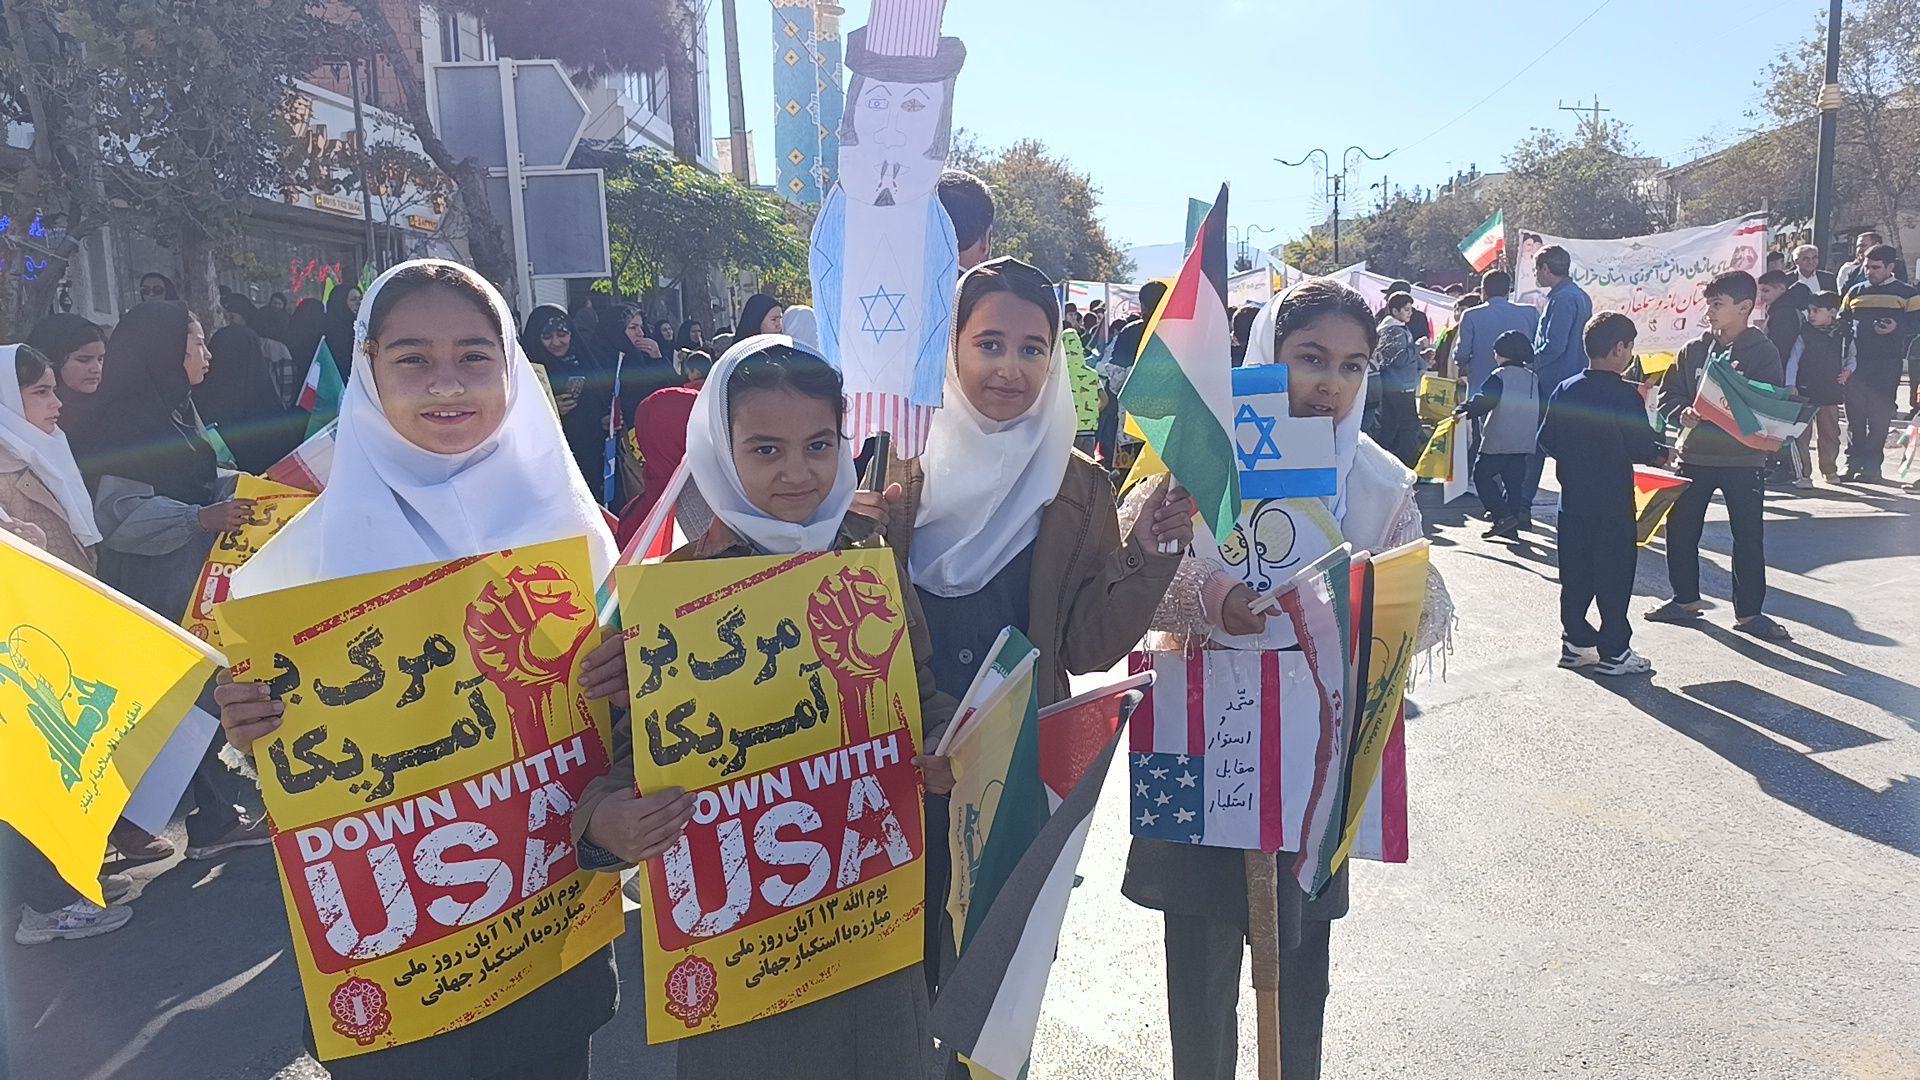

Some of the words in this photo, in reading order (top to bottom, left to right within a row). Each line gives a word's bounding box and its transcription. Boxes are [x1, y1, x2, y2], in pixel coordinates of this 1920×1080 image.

[1572, 267, 1600, 287] خراسا
[1599, 268, 1625, 286] استان
[210, 563, 240, 578] DO
[636, 623, 679, 699] بر
[687, 604, 802, 687] مرگ
[313, 624, 456, 708] مرگ
[645, 660, 831, 777] آمریکا
[268, 672, 497, 803] آمریکا
[1208, 731, 1252, 750] استوار
[691, 767, 794, 825] OWN
[799, 734, 900, 791] WITH
[1216, 759, 1255, 779] مقابل
[295, 792, 458, 863] DOWN
[464, 736, 587, 810] WITH
[1209, 782, 1253, 813] استکبار
[304, 781, 577, 960] USA
[662, 774, 914, 938] USA
[531, 892, 556, 917] الله
[557, 878, 581, 907] یوم
[843, 889, 865, 912] الله
[866, 884, 888, 909] یوم
[543, 902, 586, 937] مبارزه
[785, 906, 815, 944] آبان
[841, 923, 853, 943] با
[852, 909, 892, 939] مبارزه
[465, 920, 498, 959] آبان
[530, 928, 544, 944] با
[725, 936, 755, 968] ملی
[758, 931, 783, 956] روز
[793, 930, 841, 970] استکبار
[432, 951, 463, 975] روز
[478, 932, 531, 984] استکبار
[745, 955, 791, 989] جهانی
[393, 961, 428, 988] ملی
[420, 968, 474, 1007] جهانی
